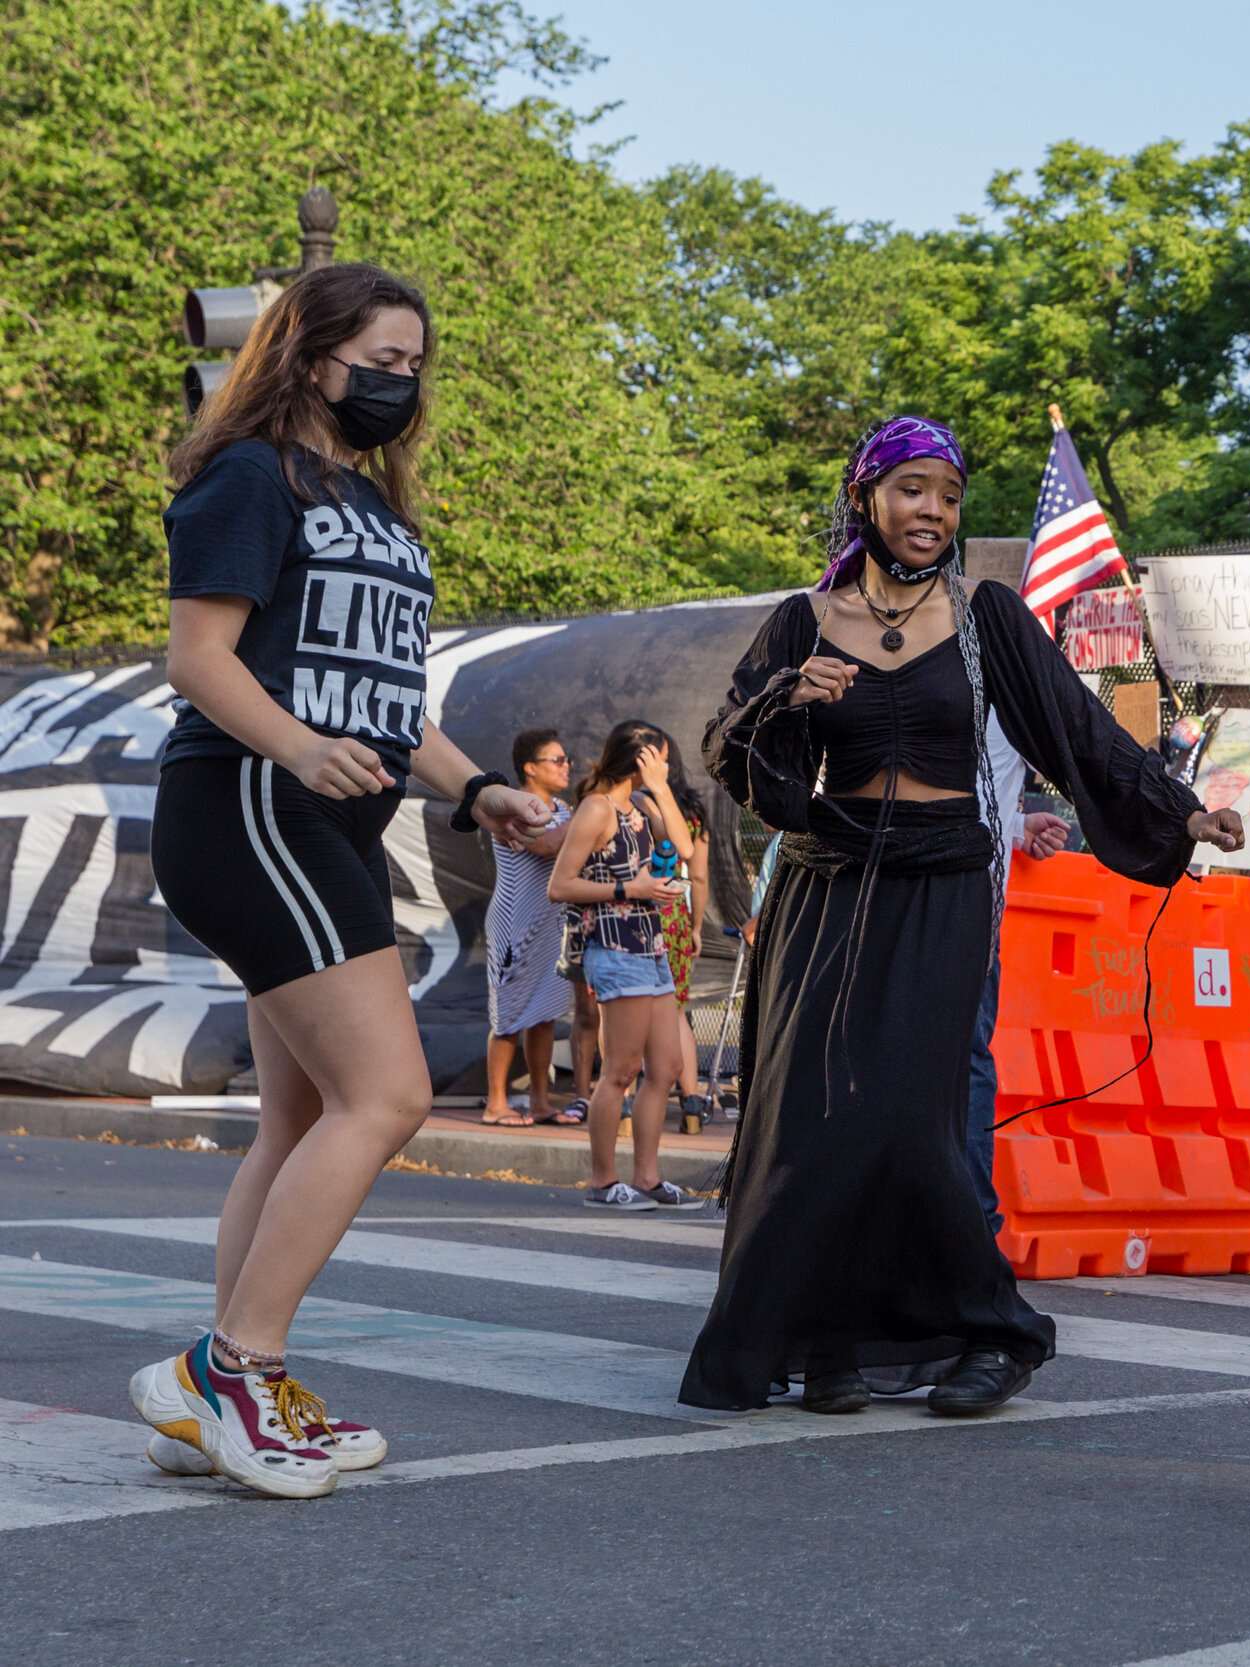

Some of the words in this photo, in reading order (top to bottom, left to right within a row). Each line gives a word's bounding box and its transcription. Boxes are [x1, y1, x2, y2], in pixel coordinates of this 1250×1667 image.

[1171, 573, 1216, 606] pray
[302, 574, 427, 667] LIVES
[1067, 590, 1118, 629] REWRITE
[1066, 625, 1141, 669] CONSTITUTION
[1198, 959, 1227, 997] d.
